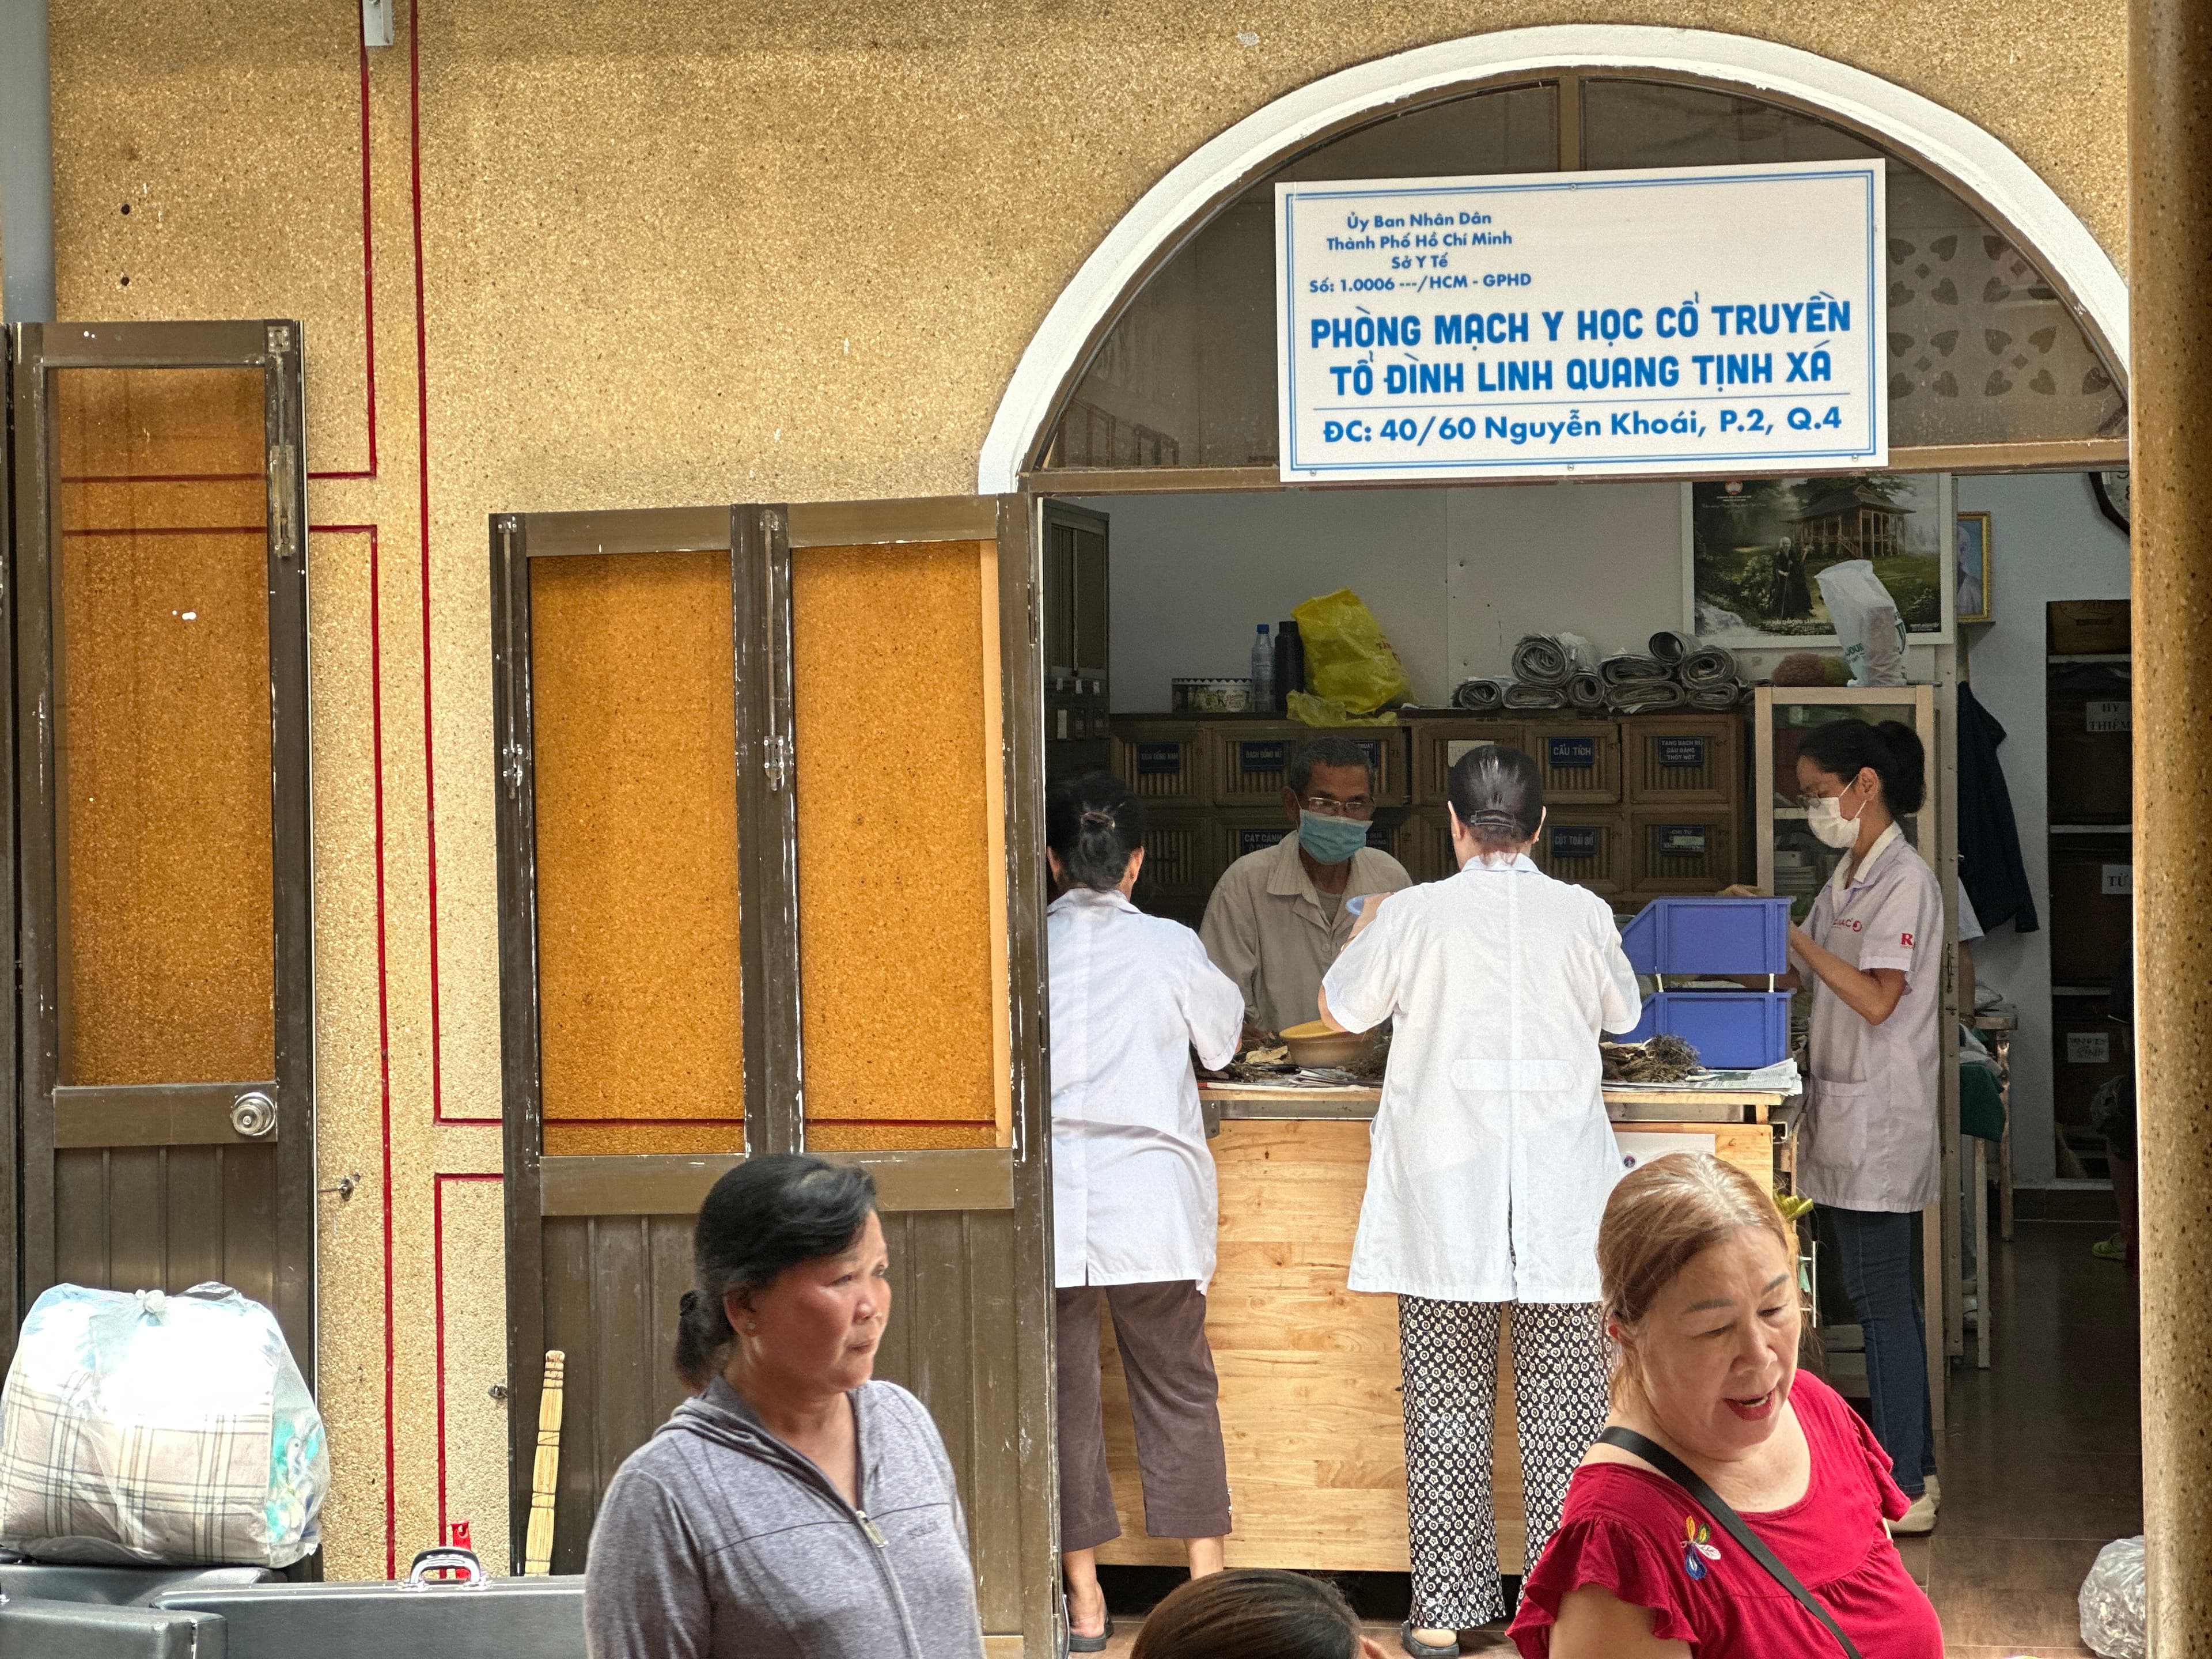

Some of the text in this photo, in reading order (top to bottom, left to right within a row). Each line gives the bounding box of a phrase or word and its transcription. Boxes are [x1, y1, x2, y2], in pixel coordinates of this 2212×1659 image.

[1347, 211, 1492, 232] Ủy Ban Nhân Dân
[1327, 230, 1513, 250] Thành Phố Hồ Chí Minh
[1391, 252, 1449, 269] Sở Y Tế
[1309, 278, 1335, 293] Số:
[1340, 278, 1395, 291] 1.0006
[1483, 273, 1532, 287] GPHD
[1310, 291, 1851, 350] PHÒNG MẠCH Y HỌC CỔ TRUYỀN
[1329, 340, 1831, 396] TỔ ĐÌNH LINH QUANG TỊNH XÁ
[1323, 406, 1842, 446] ĐC: 40/60 Nguyễn Khoái, P.2, Q.4
